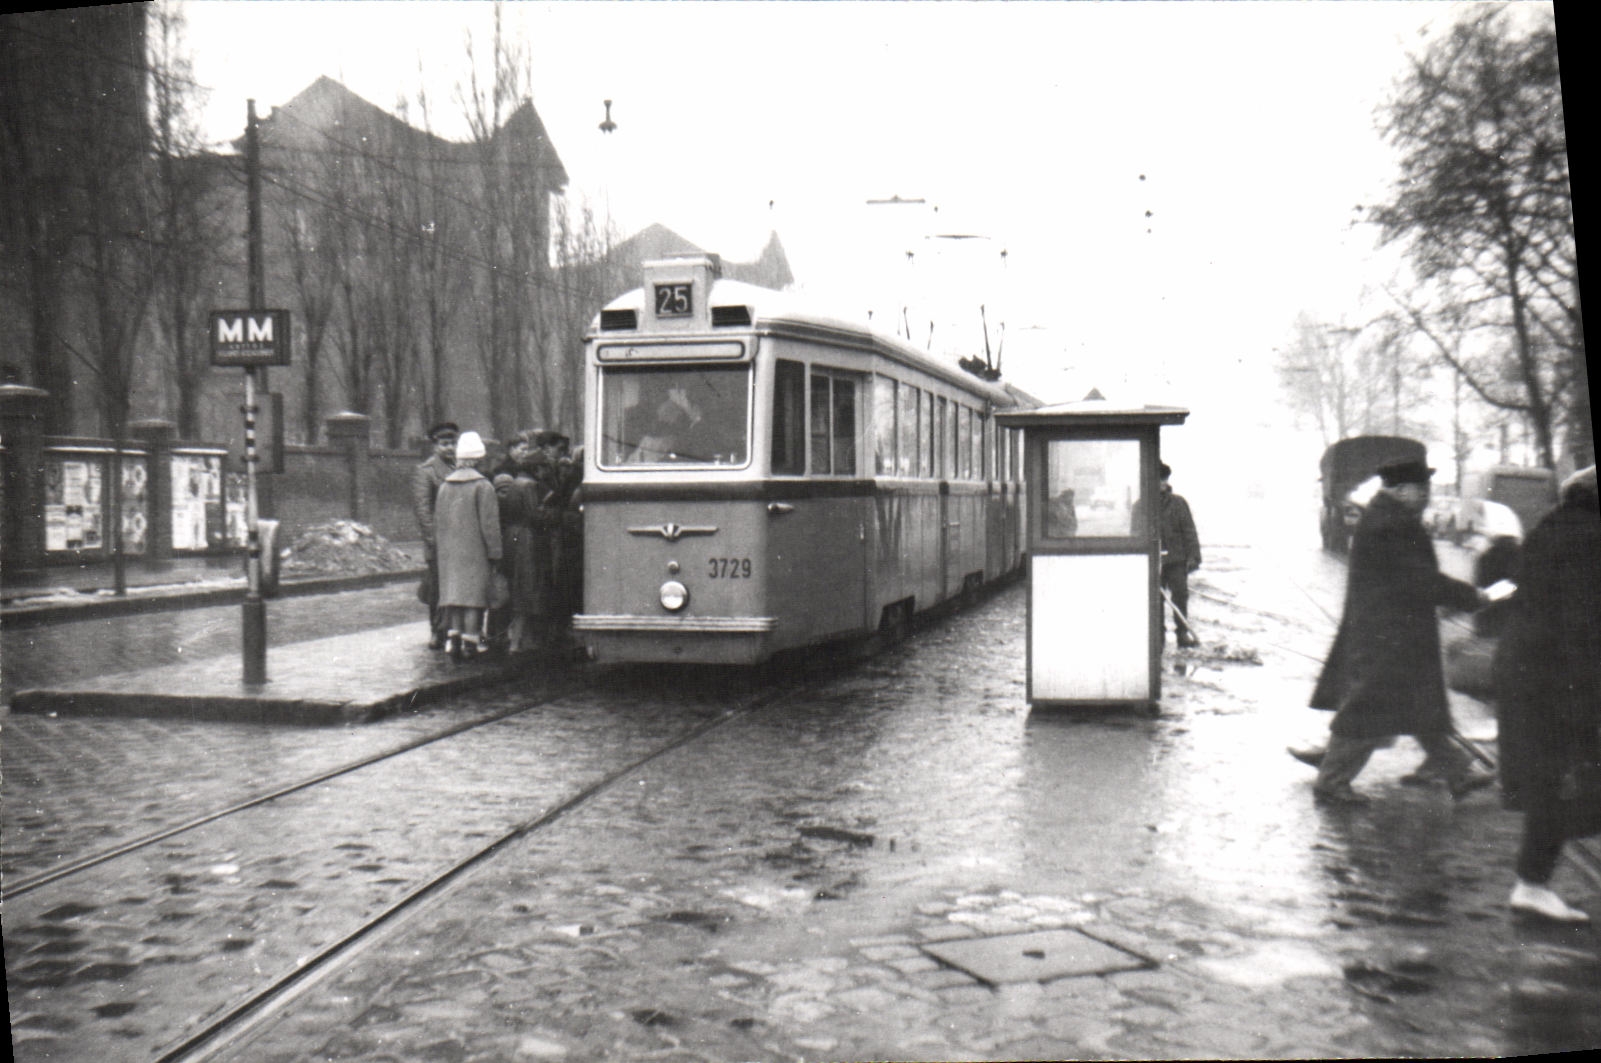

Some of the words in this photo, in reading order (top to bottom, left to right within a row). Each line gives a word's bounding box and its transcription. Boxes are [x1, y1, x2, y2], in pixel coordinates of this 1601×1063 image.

[659, 286, 688, 314] 25
[218, 317, 273, 342] MM
[708, 557, 752, 579] 3729
